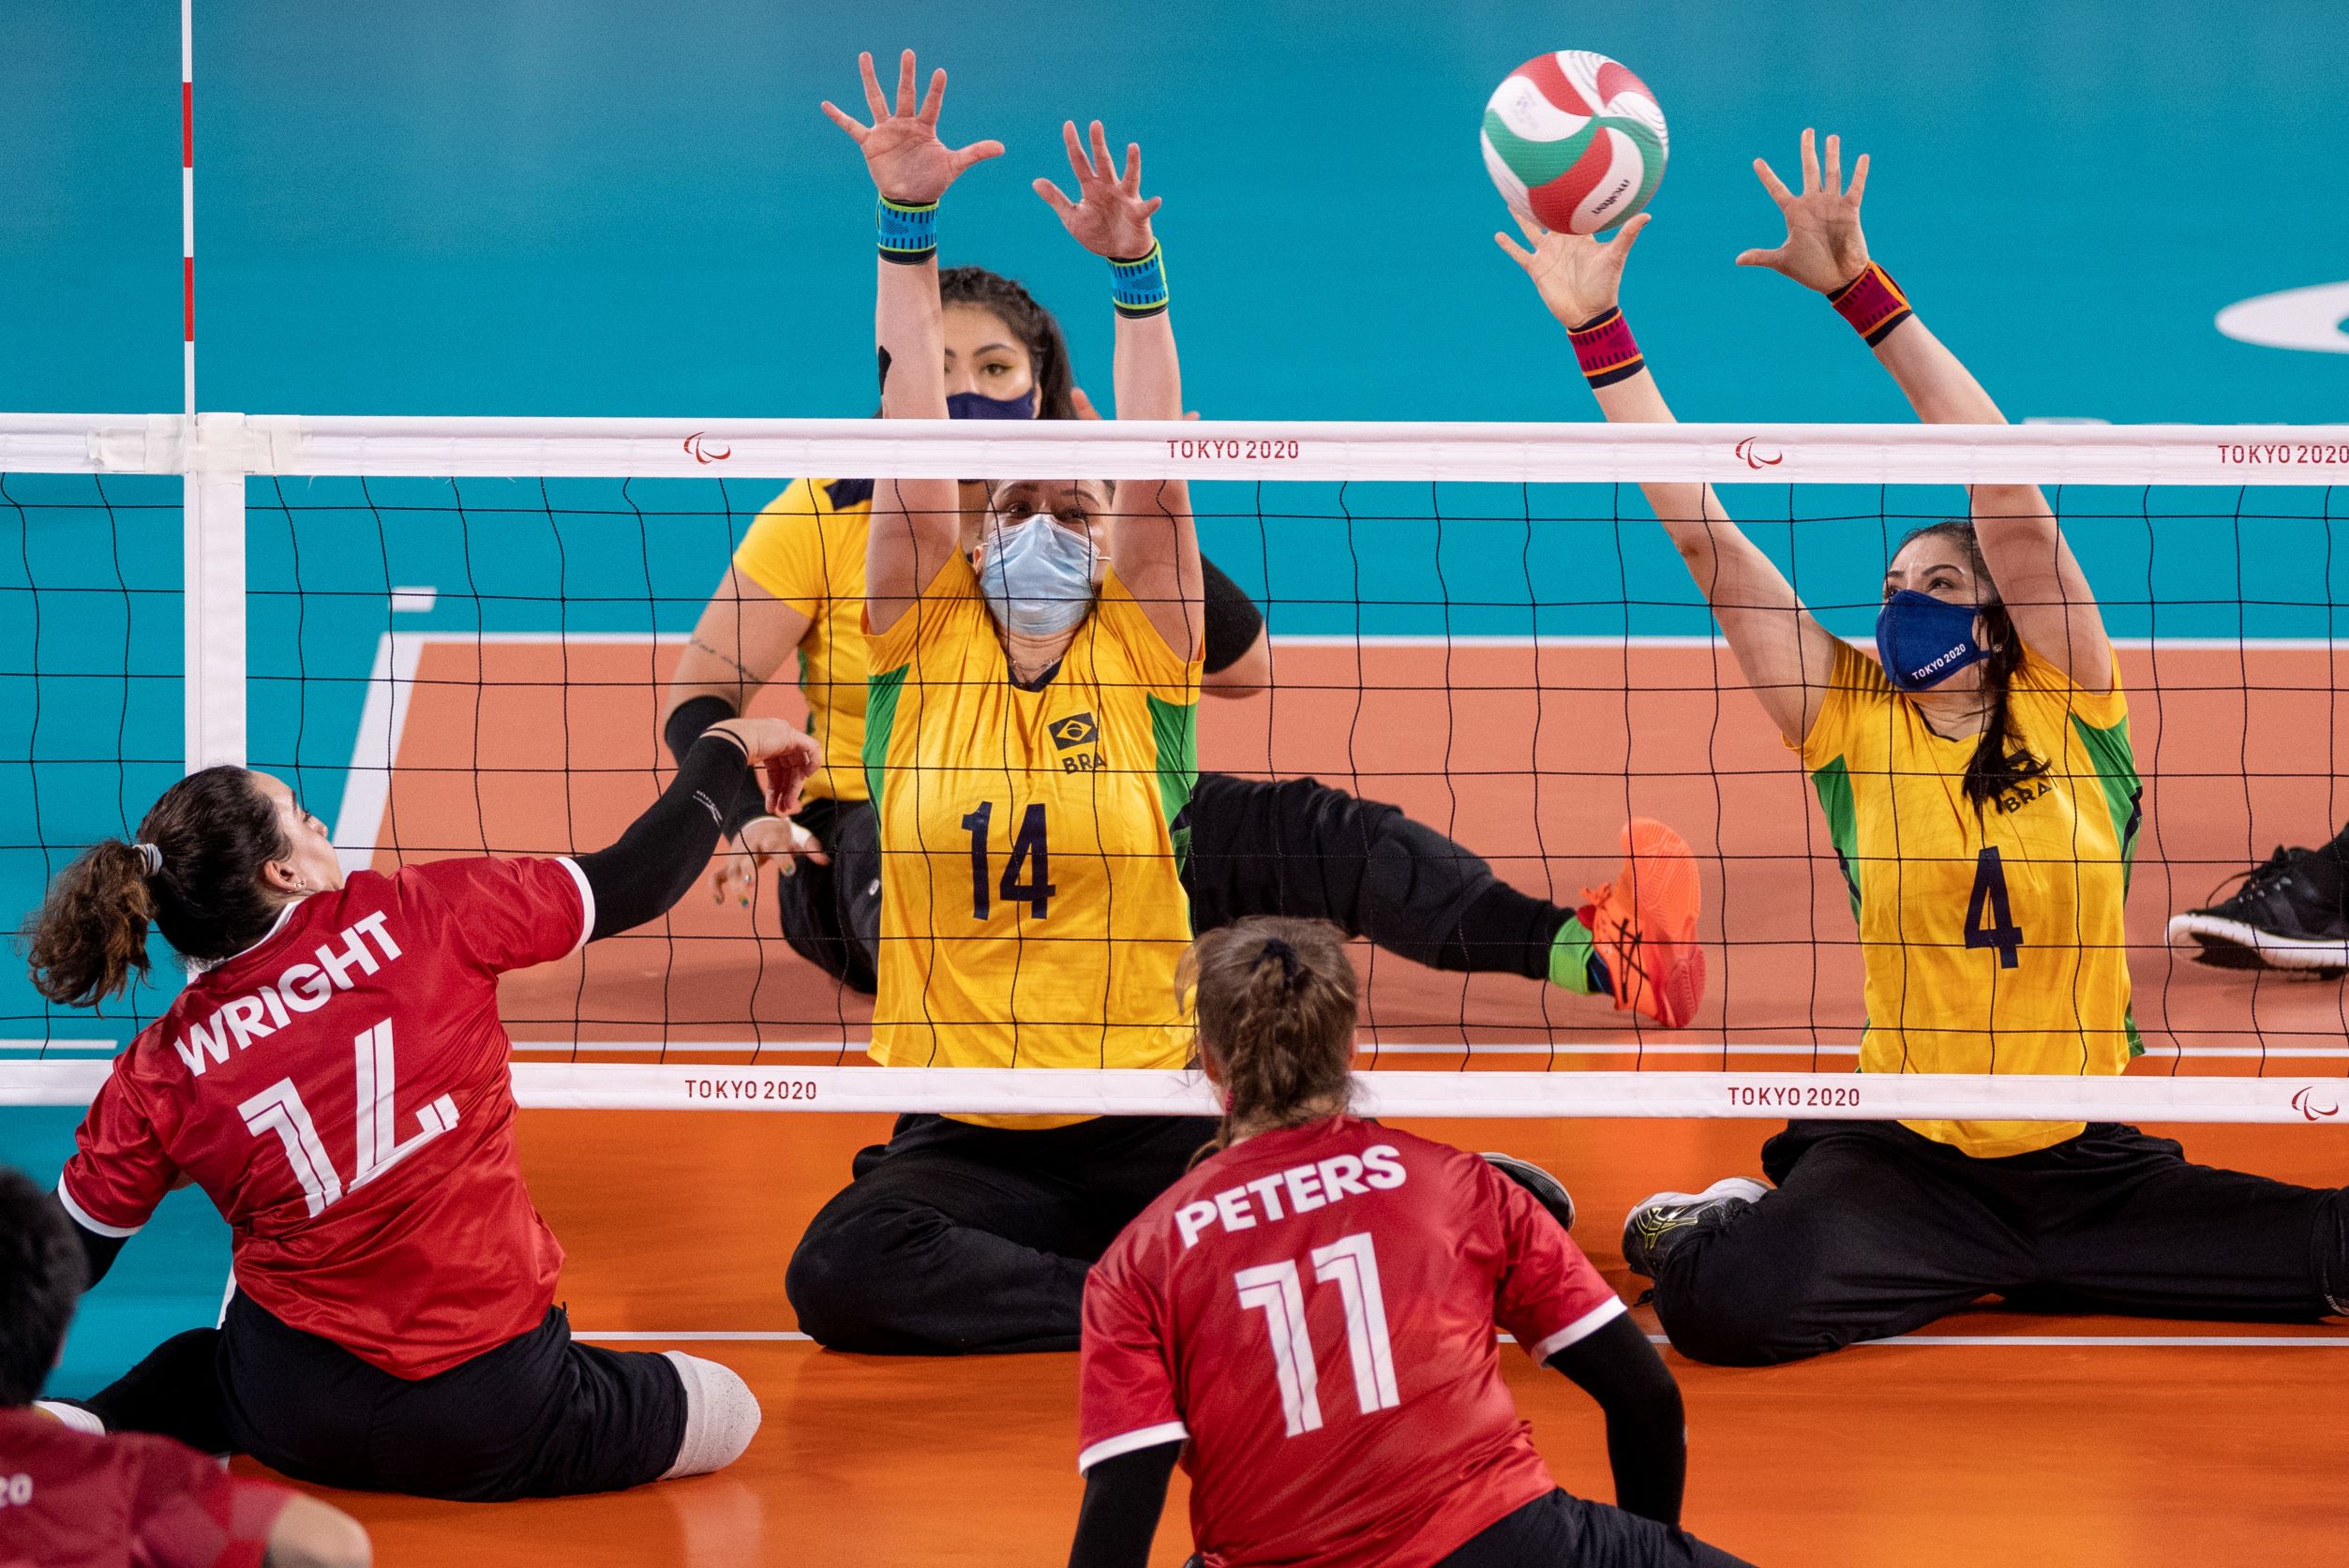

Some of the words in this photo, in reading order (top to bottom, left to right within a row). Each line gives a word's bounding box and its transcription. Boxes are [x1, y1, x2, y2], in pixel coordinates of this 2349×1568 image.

[1167, 440, 1239, 459] TOKYO
[1246, 440, 1299, 459] 2020
[2218, 444, 2291, 464] TOKYO
[2297, 444, 2349, 464] 2020
[1911, 658, 1945, 680] TOKYO
[1943, 643, 1967, 664] 2020
[1061, 753, 1108, 775] BRA
[2003, 782, 2053, 814] BRA
[961, 800, 1056, 920] 14
[1964, 845, 2024, 969] 4
[173, 910, 403, 1078] WRIGHT
[685, 1080, 757, 1099] TOKYO
[763, 1081, 816, 1099] 2020
[1728, 1087, 1800, 1106] TOKYO
[1807, 1088, 1860, 1107] 2020
[237, 1017, 461, 1219] 14
[1175, 1144, 1407, 1249] PETERS
[1234, 1232, 1400, 1439] 11
